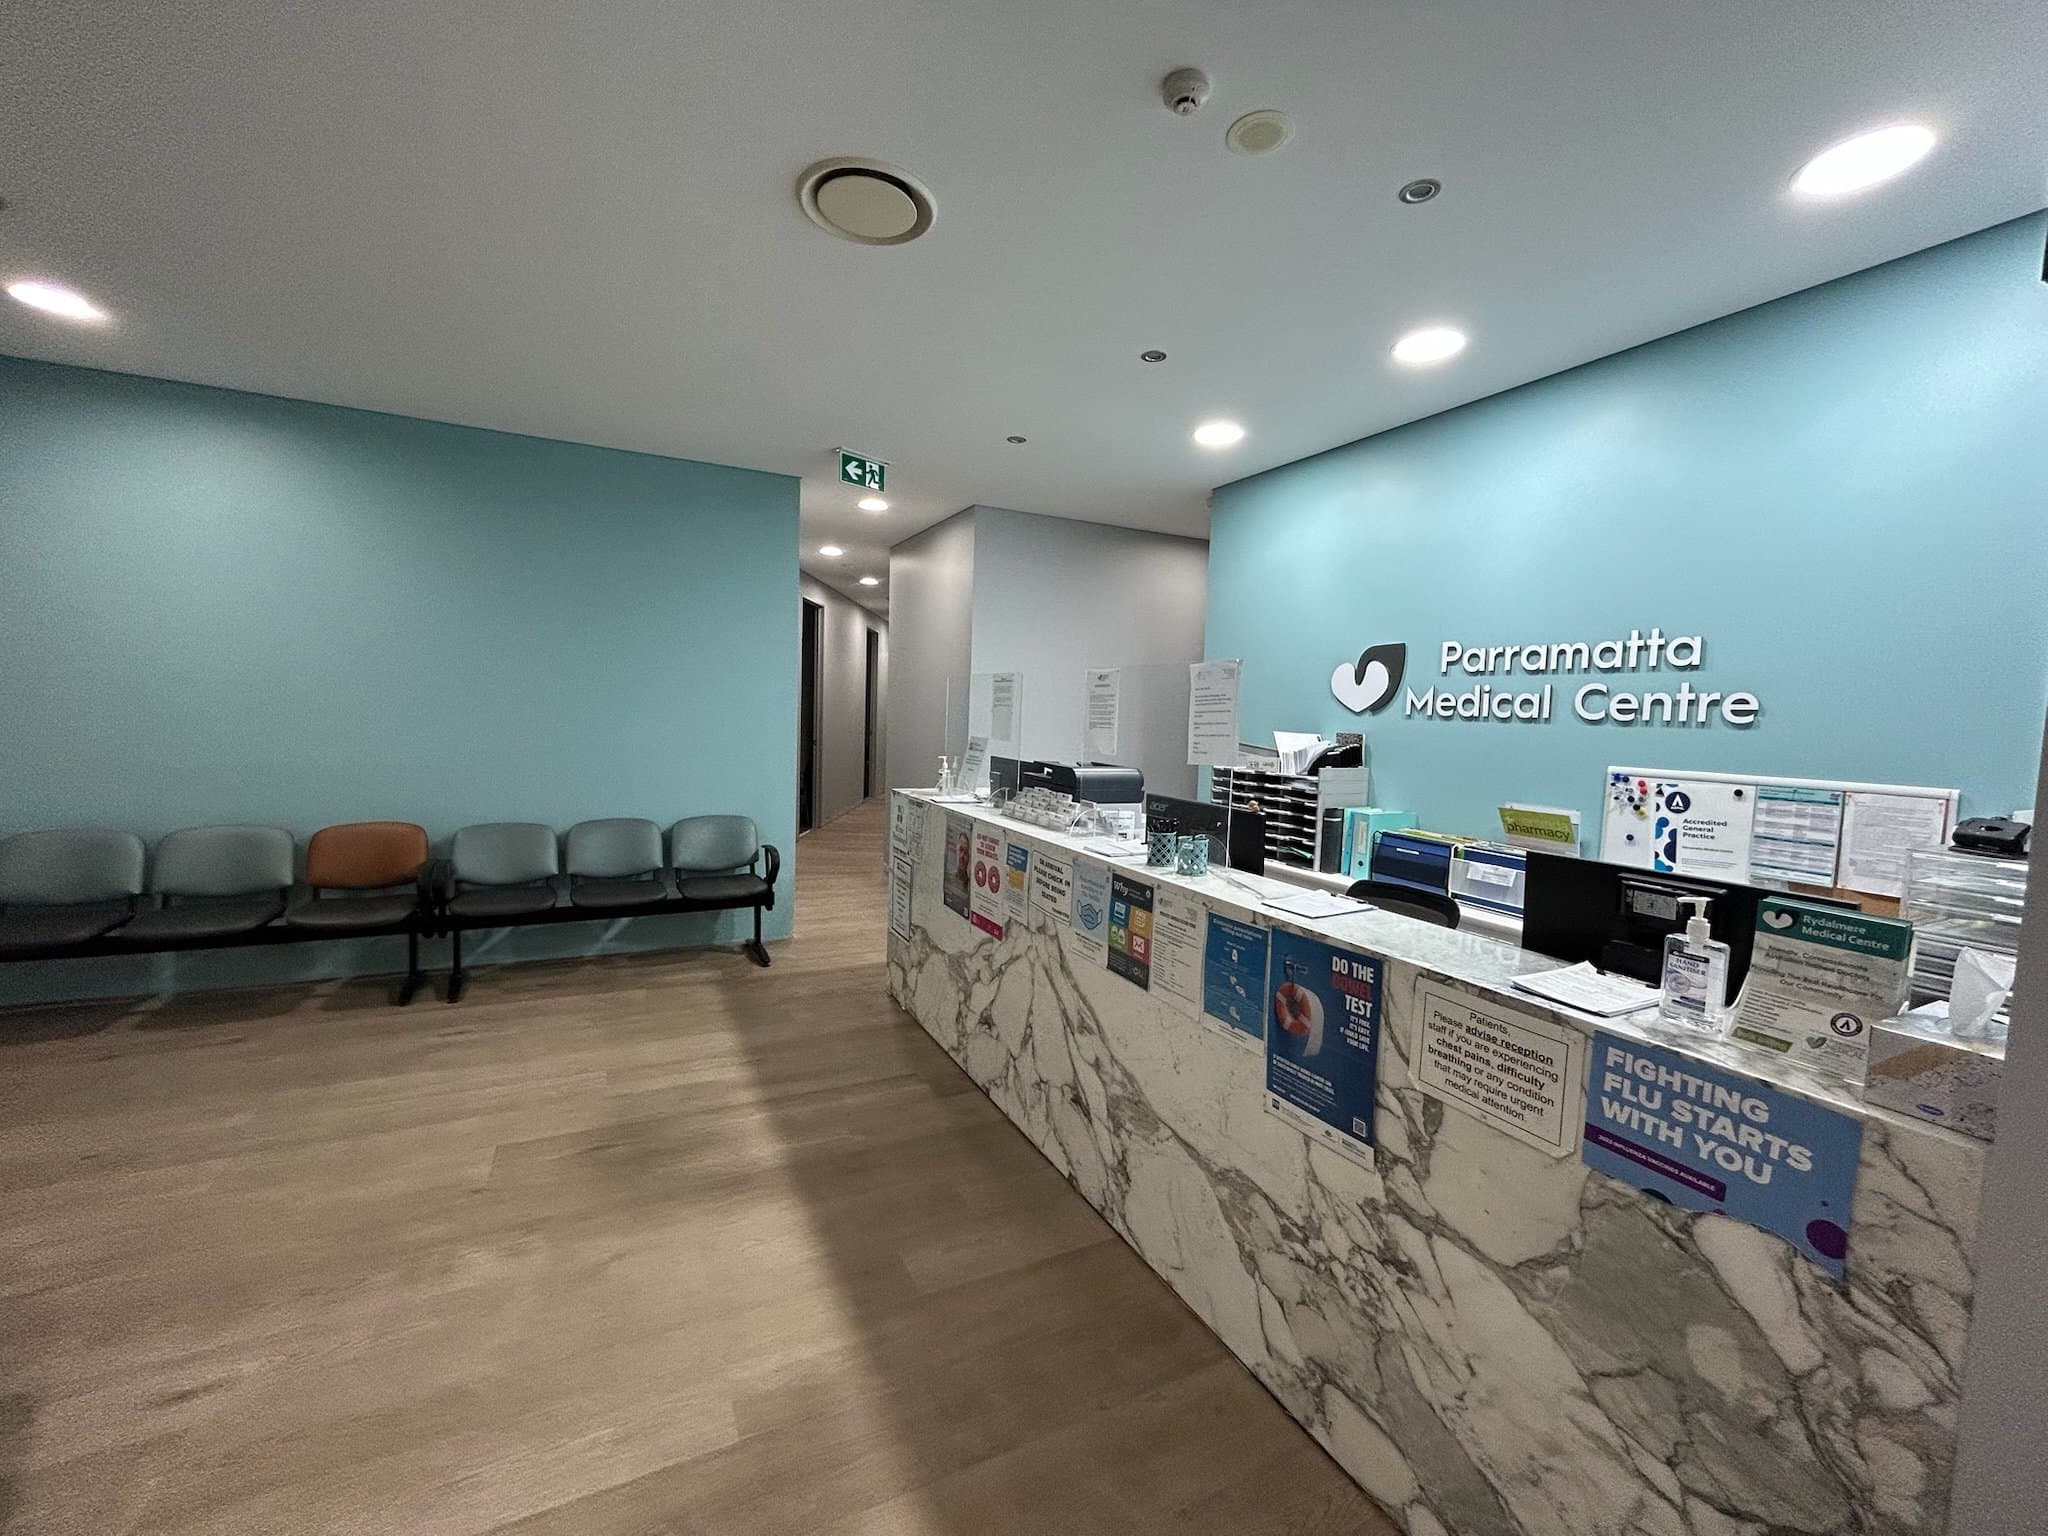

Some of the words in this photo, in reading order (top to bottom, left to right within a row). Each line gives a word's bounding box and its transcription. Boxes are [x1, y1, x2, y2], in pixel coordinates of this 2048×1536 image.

[1440, 627, 1703, 673] Parramatta
[1405, 684, 1551, 720] Medical
[1574, 681, 1760, 724] Centre
[1507, 823, 1570, 841] pharmacy
[1682, 825, 1714, 833] General
[1682, 832, 1716, 840] Practice
[1683, 818, 1728, 827] Accredited
[1801, 926, 1846, 942] Medical
[1848, 935, 1890, 950] Centre
[1803, 915, 1866, 934] Rydalmere
[1332, 956, 1349, 975] DO
[1351, 962, 1375, 984] THE
[1669, 962, 1706, 977] SANITISER
[1676, 958, 1700, 968] HAND
[1344, 994, 1373, 1019] TEST
[1428, 1021, 1447, 1034] staff
[1448, 1028, 1454, 1038] if
[1456, 1032, 1472, 1046] you
[1475, 1042, 1490, 1053] are
[1492, 1049, 1559, 1083] experiencing
[1433, 1010, 1464, 1030] Please
[1465, 1024, 1499, 1045] advise
[1501, 1039, 1554, 1066] reception
[1428, 1045, 1472, 1072] breathing
[1474, 1065, 1485, 1074] or
[1486, 1071, 1504, 1086] any
[1507, 1080, 1555, 1107] condition
[1436, 1037, 1462, 1054] chest
[1497, 1063, 1545, 1091] difficulty
[1434, 1060, 1451, 1075] that
[1452, 1069, 1472, 1085] may
[1474, 1079, 1508, 1100] require
[1510, 1095, 1545, 1117] urgent
[1445, 1077, 1480, 1099] medical
[1606, 1046, 1770, 1123] FIGHTING
[1603, 1072, 1662, 1110] FLU
[1671, 1099, 1813, 1172] STARTS
[1601, 1096, 1684, 1149] WITH
[1693, 1133, 1773, 1185] YOU
